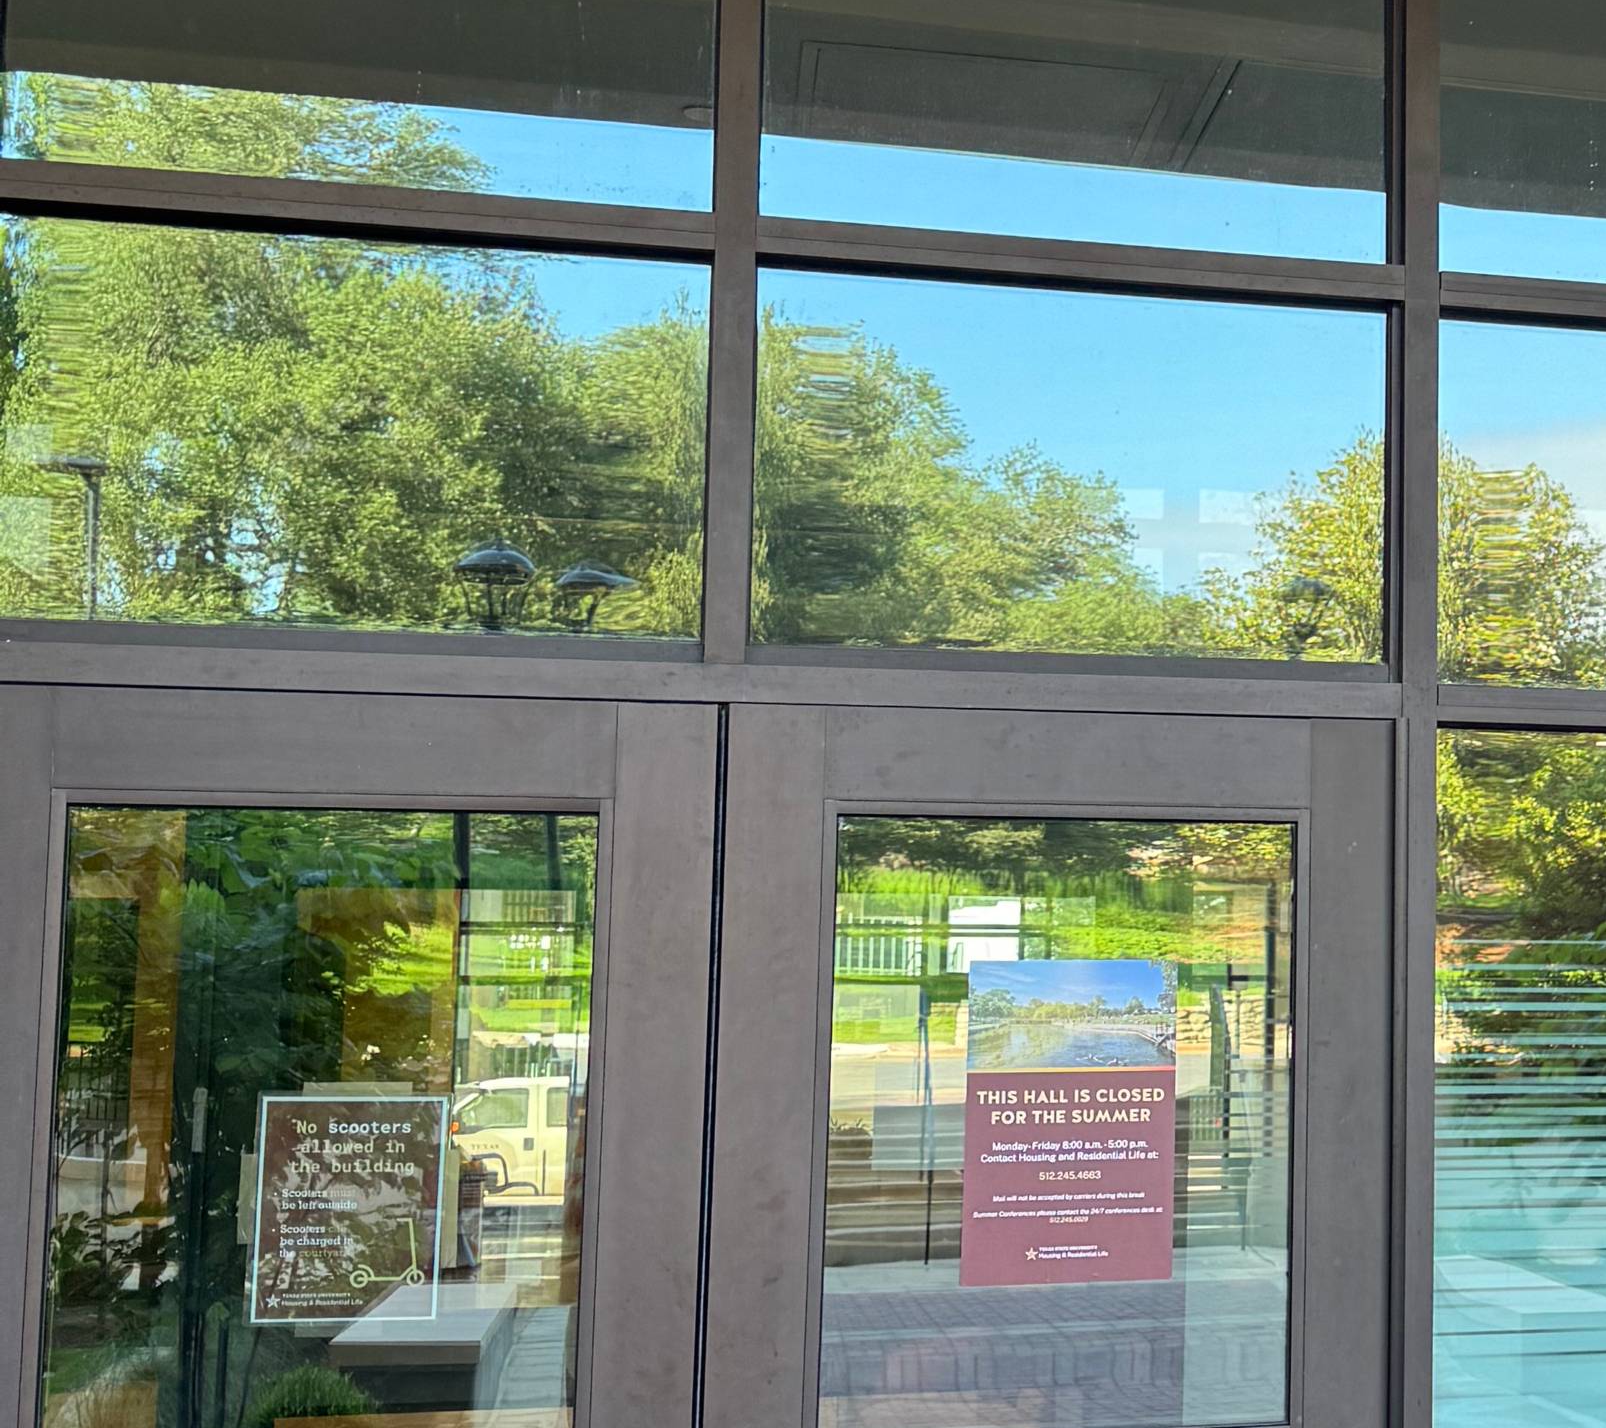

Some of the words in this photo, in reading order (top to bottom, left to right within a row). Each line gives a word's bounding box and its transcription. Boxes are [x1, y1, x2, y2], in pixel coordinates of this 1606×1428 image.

[976, 1090, 1018, 1105] THIS
[1023, 1089, 1069, 1104] HALL
[1074, 1089, 1091, 1103] IS
[1096, 1088, 1165, 1103] CLOSED
[991, 1110, 1027, 1125] FOR
[1032, 1109, 1066, 1124] THE
[1071, 1108, 1151, 1124] SUMMER
[296, 1120, 317, 1134] No
[328, 1121, 412, 1134] scooters
[301, 1139, 374, 1153] allowed
[385, 1138, 405, 1153] in
[1084, 1141, 1103, 1149] a.m.
[1107, 1139, 1129, 1149] 5:00
[1129, 1140, 1149, 1149] p.m.
[980, 1154, 1017, 1163] Contact
[1018, 1153, 1057, 1163] Housing
[1058, 1152, 1075, 1161] and
[1077, 1151, 1127, 1161] Residential
[1128, 1151, 1145, 1160] Life
[291, 1160, 320, 1173] the
[332, 1159, 415, 1176] building
[282, 1200, 296, 1209] be
[298, 1200, 316, 1210] left
[318, 1200, 358, 1210] outside
[280, 1224, 326, 1234] Scooters
[280, 1237, 294, 1246] be
[296, 1236, 341, 1247] charged
[344, 1236, 354, 1245] in
